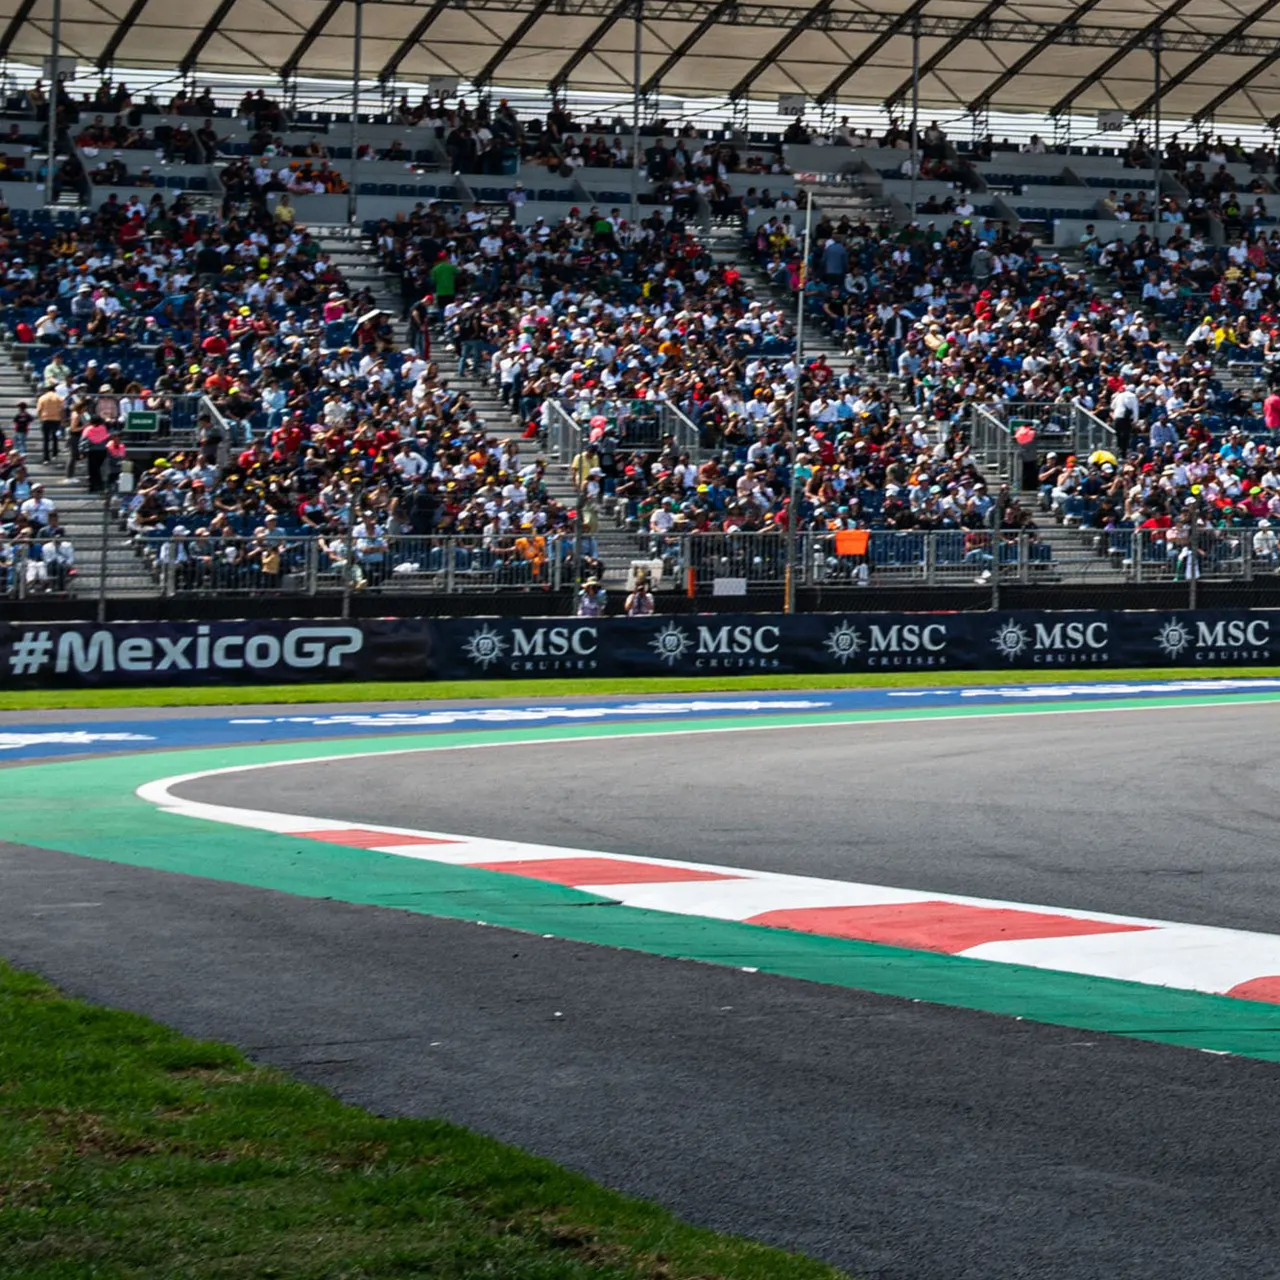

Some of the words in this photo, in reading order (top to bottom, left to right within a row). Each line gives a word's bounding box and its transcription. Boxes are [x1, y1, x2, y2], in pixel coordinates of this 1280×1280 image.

[512, 626, 597, 656] MSC
[695, 625, 780, 654] MSC
[869, 624, 946, 652] MSC
[1034, 622, 1108, 649] MSC
[1196, 619, 1270, 647] MSC
[9, 625, 363, 675] #MexicoGP
[696, 658, 778, 666] CRUISES
[868, 656, 945, 664] CRUISES
[1034, 653, 1108, 662] CRUISES
[1196, 650, 1269, 659] CRUISES
[511, 660, 596, 669] CRUISES
